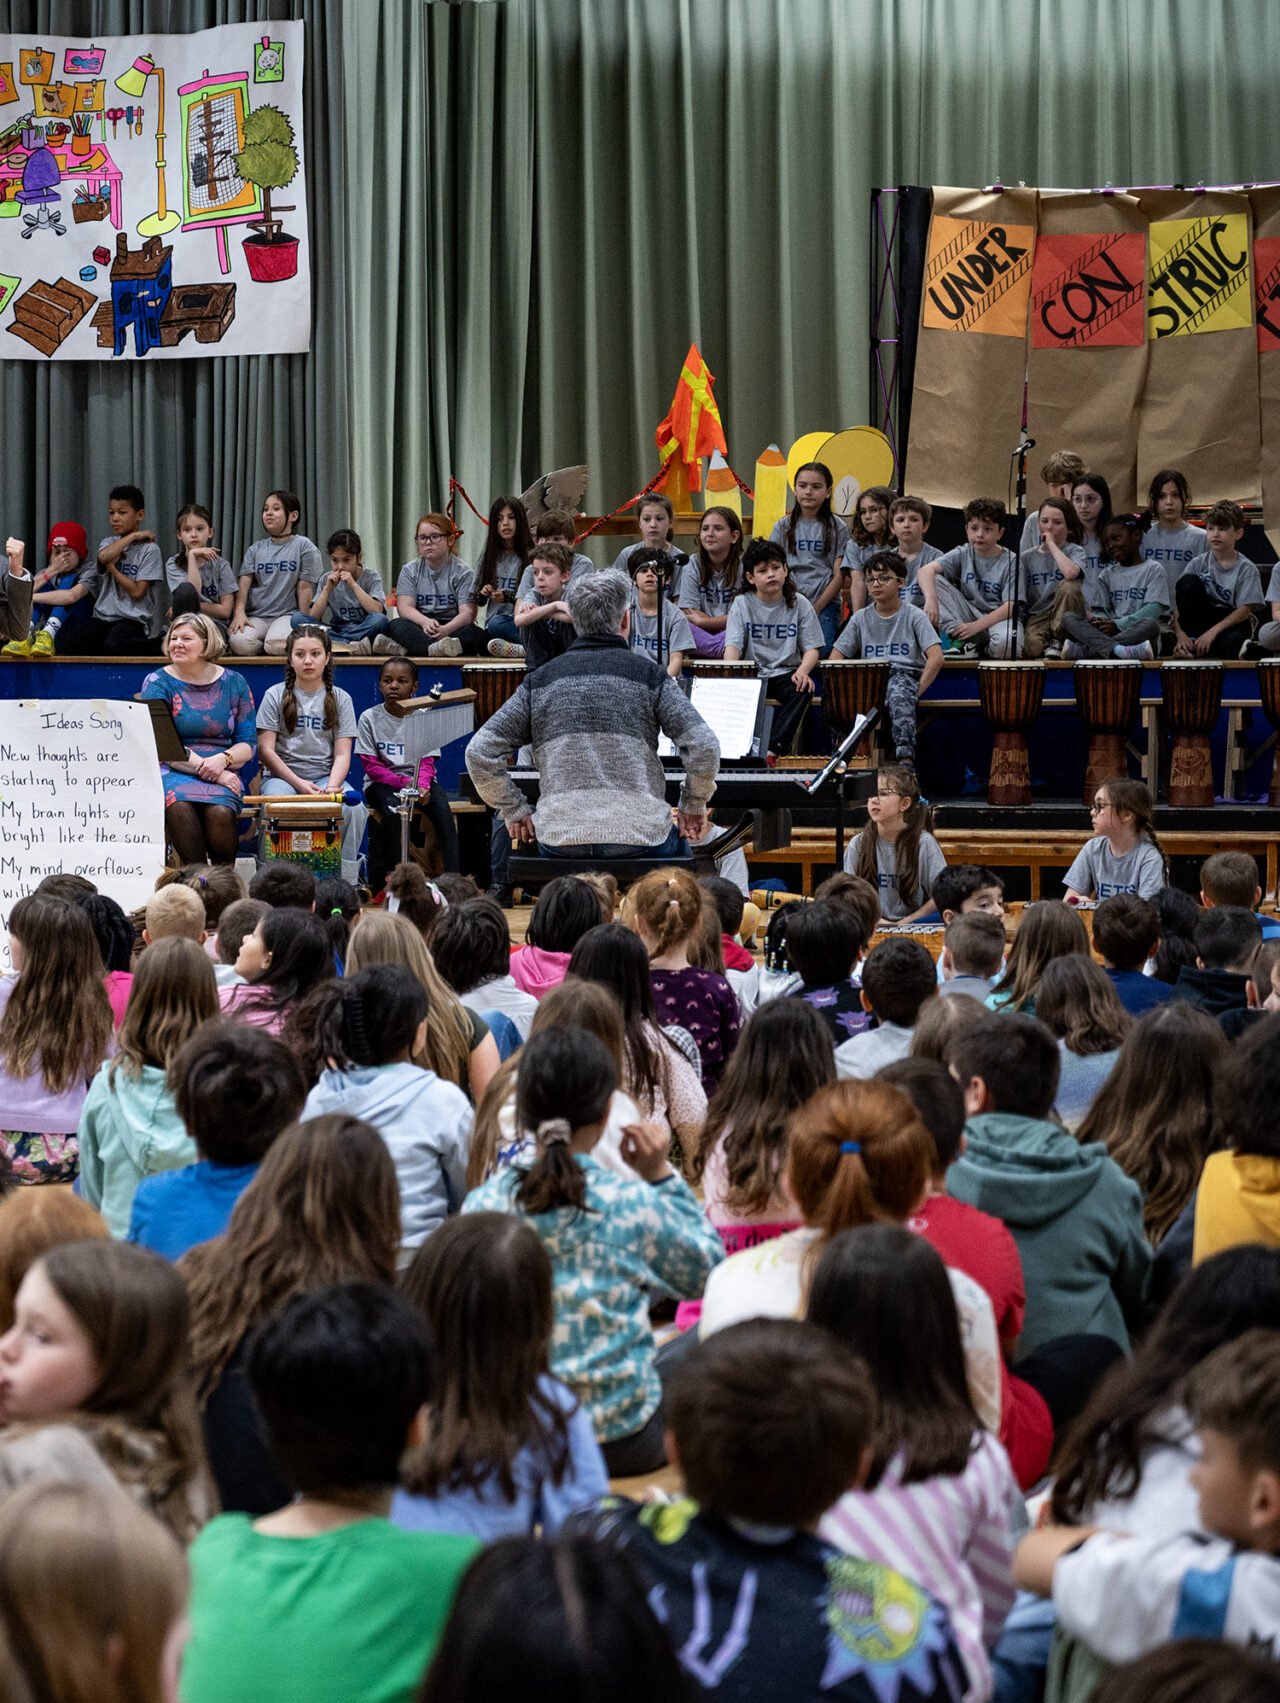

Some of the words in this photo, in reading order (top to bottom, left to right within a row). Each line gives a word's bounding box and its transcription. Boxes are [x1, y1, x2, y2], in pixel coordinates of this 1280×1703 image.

[927, 226, 1028, 321] UNDER
[1040, 250, 1135, 340] CON
[1145, 548, 1194, 562] PETES
[40, 712, 84, 730] Ideas
[89, 711, 123, 741] Song
[1, 744, 30, 762] New
[37, 744, 88, 770] thoughts
[96, 751, 120, 763] are
[0, 770, 57, 796] starting
[65, 770, 78, 786] to
[1, 800, 22, 827] My
[32, 802, 65, 819] brain
[74, 801, 110, 827] lights
[118, 809, 136, 825] up
[1, 826, 45, 851] bright
[59, 826, 85, 843] like
[95, 826, 119, 843] the
[0, 856, 23, 881] My
[30, 858, 64, 876] mind
[74, 856, 144, 876] overflows
